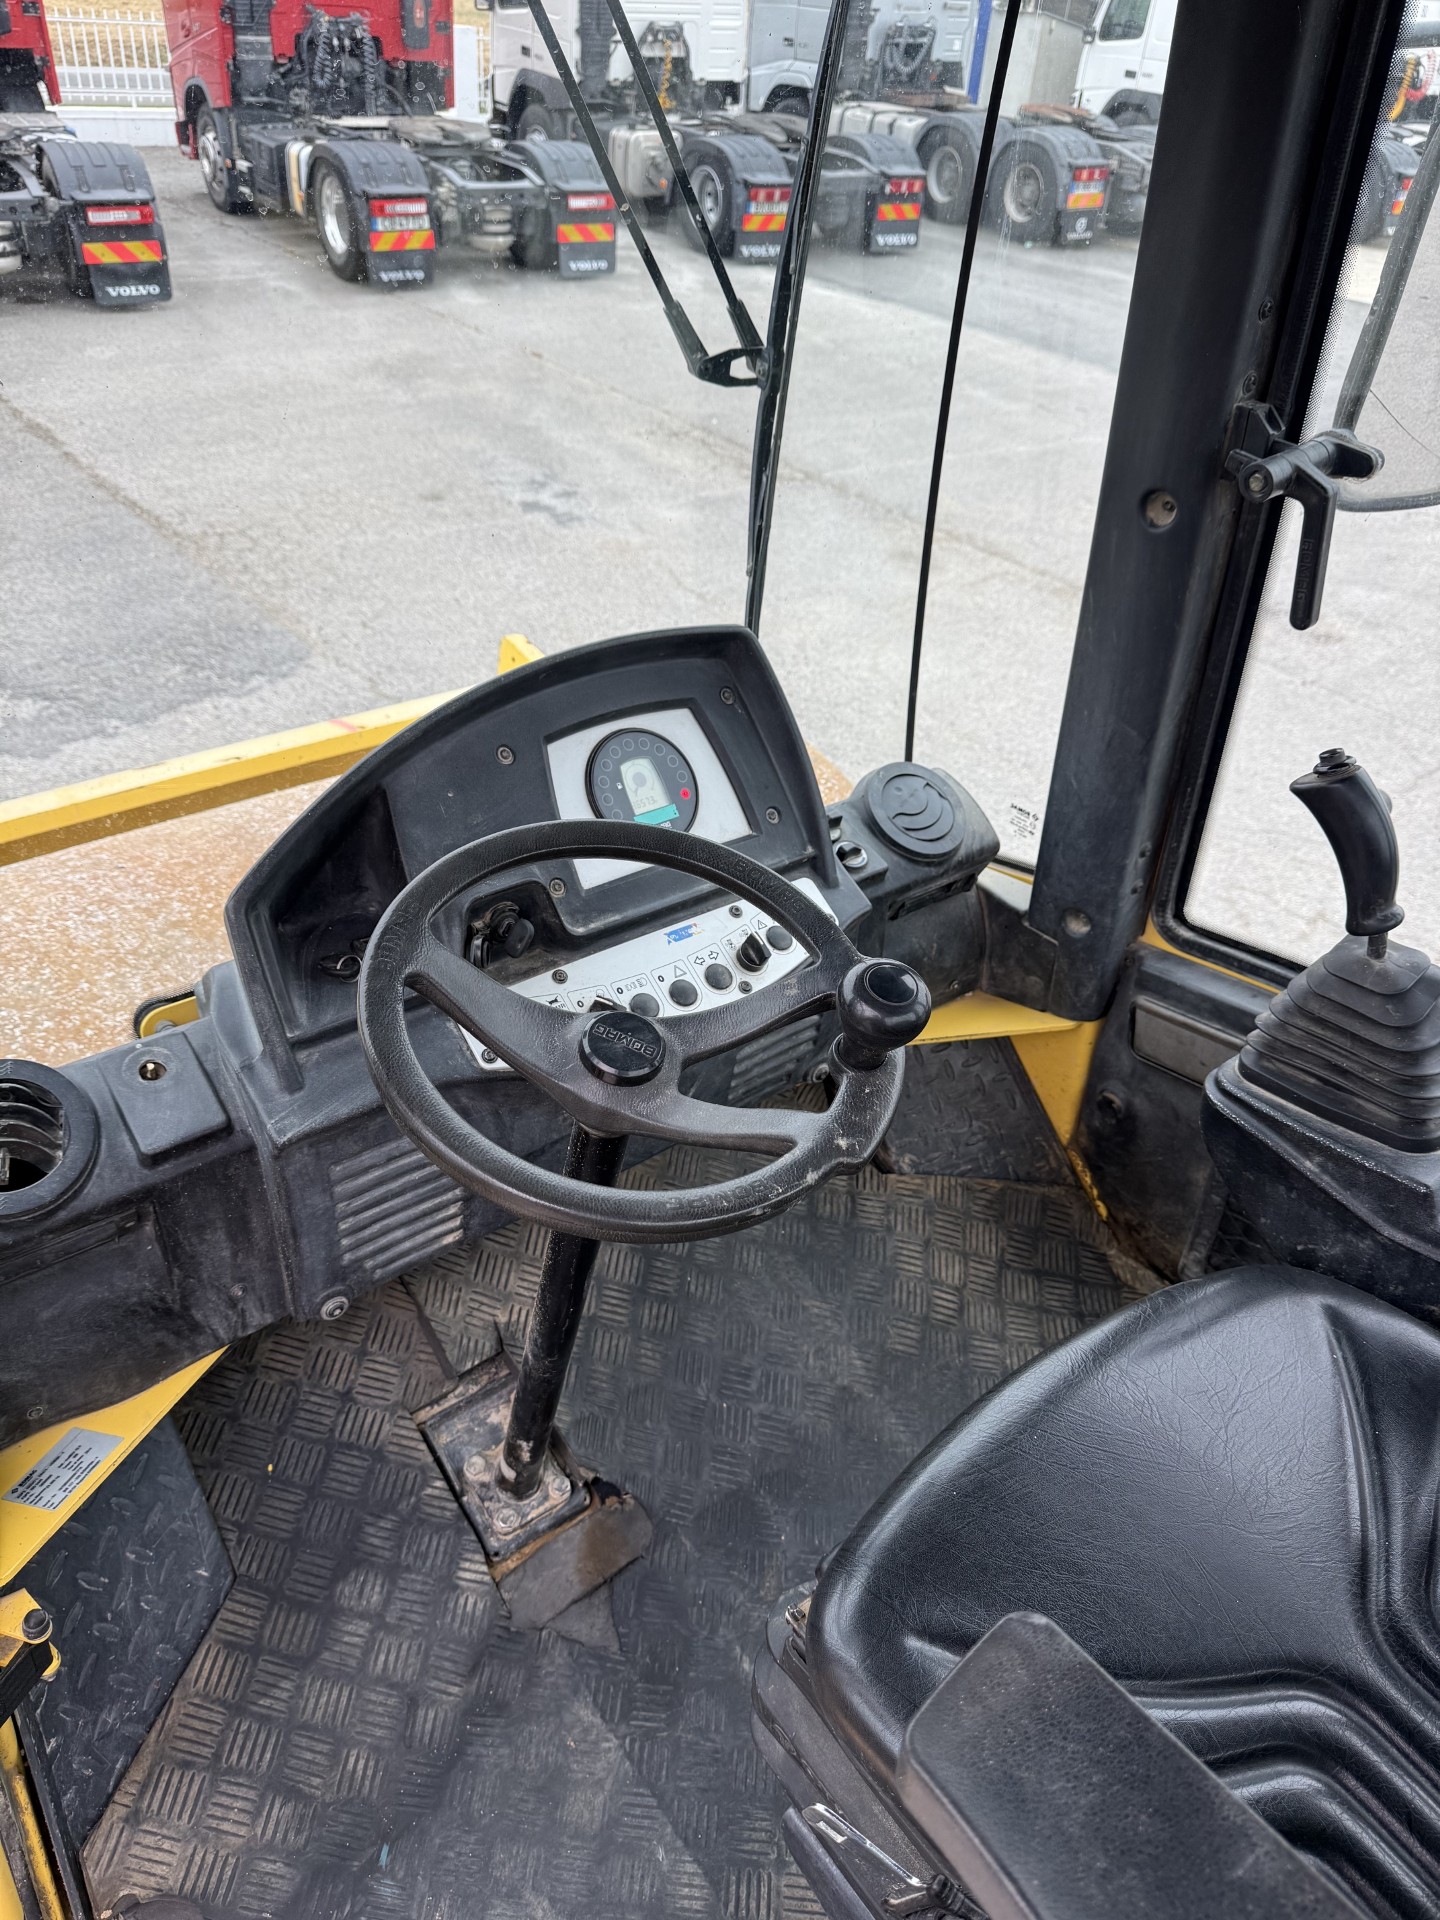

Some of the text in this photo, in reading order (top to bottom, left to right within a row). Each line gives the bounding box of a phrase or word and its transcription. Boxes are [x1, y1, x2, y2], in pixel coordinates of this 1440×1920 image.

[876, 233, 917, 246] VOLVO
[741, 244, 781, 257] VOLV
[568, 259, 609, 272] VOLVO
[380, 269, 425, 282] VOLVO
[104, 283, 161, 298] VOLVO
[592, 1022, 658, 1059] BOMAG
